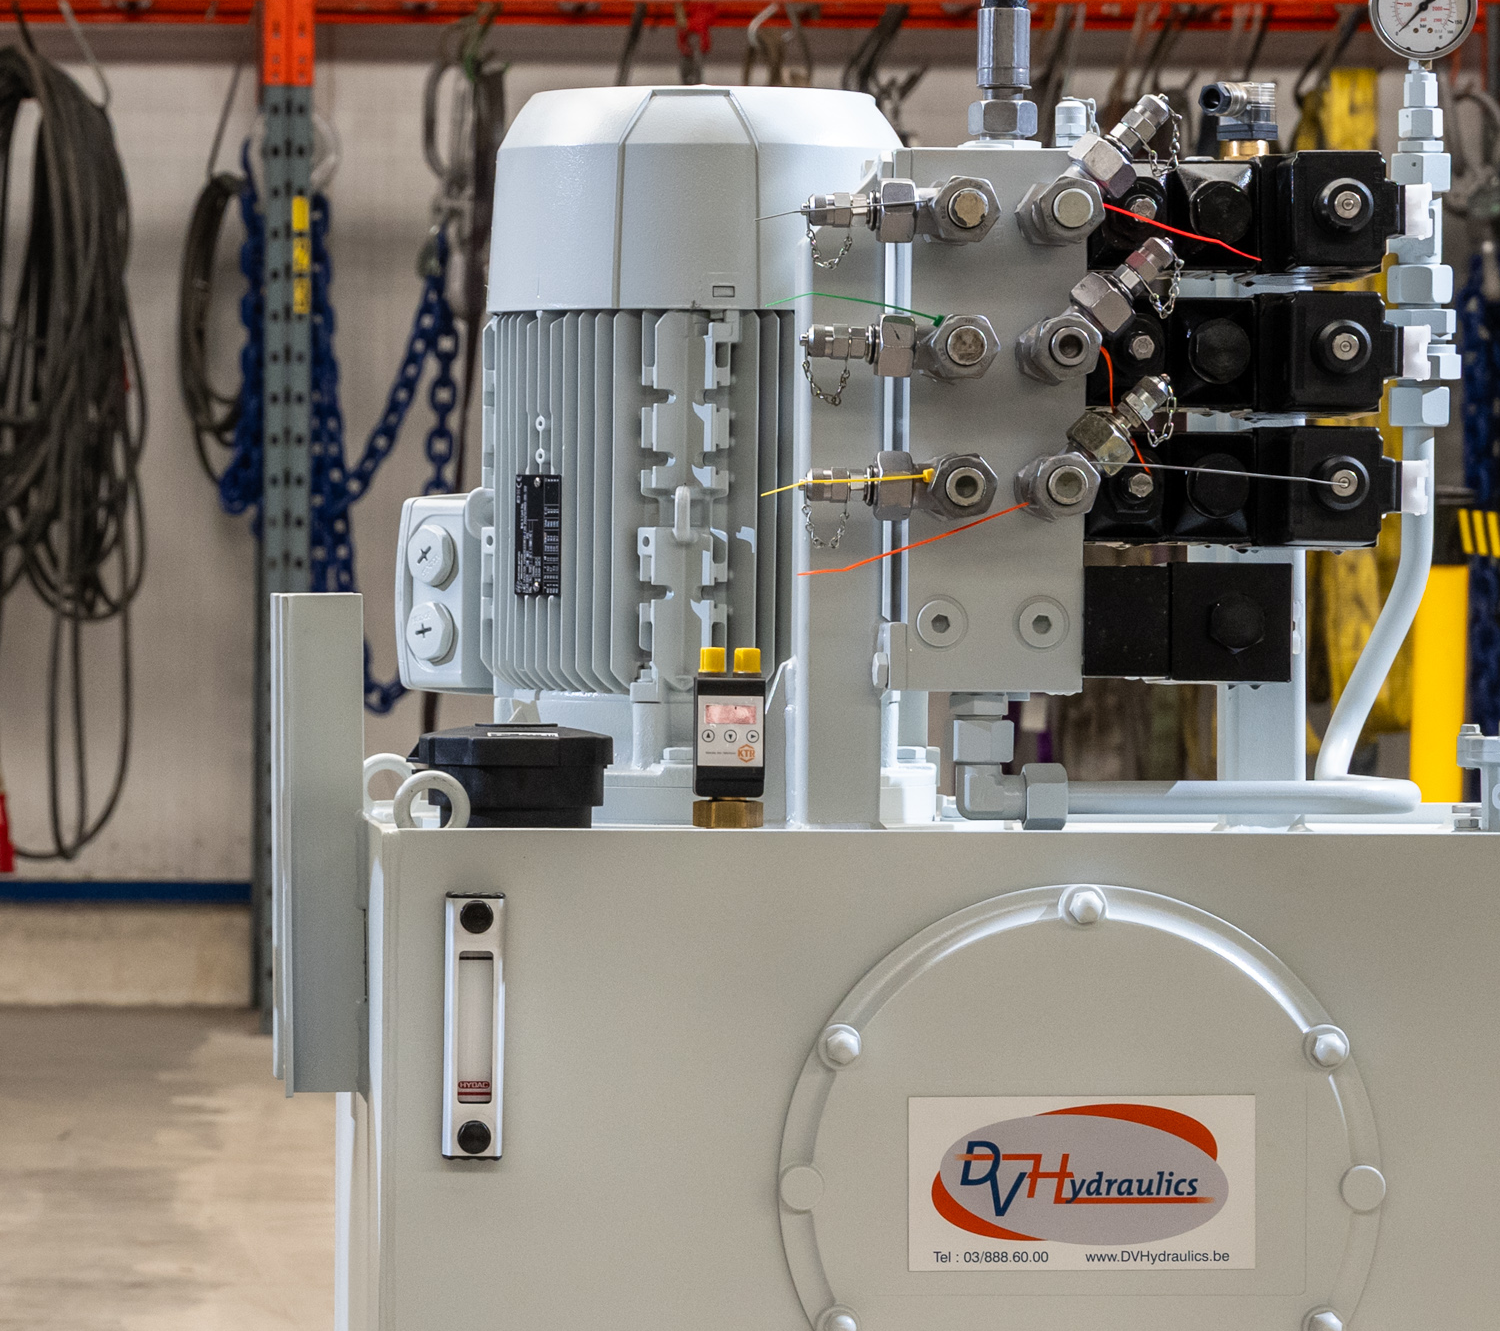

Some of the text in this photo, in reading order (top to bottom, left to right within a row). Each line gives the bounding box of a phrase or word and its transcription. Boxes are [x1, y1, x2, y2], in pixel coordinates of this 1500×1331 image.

[737, 749, 755, 758] KTR
[933, 1251, 951, 1263] Tel
[963, 1251, 1049, 1264] 03/888.60.00
[1085, 1250, 1230, 1265] www.DVHydraulics.be
